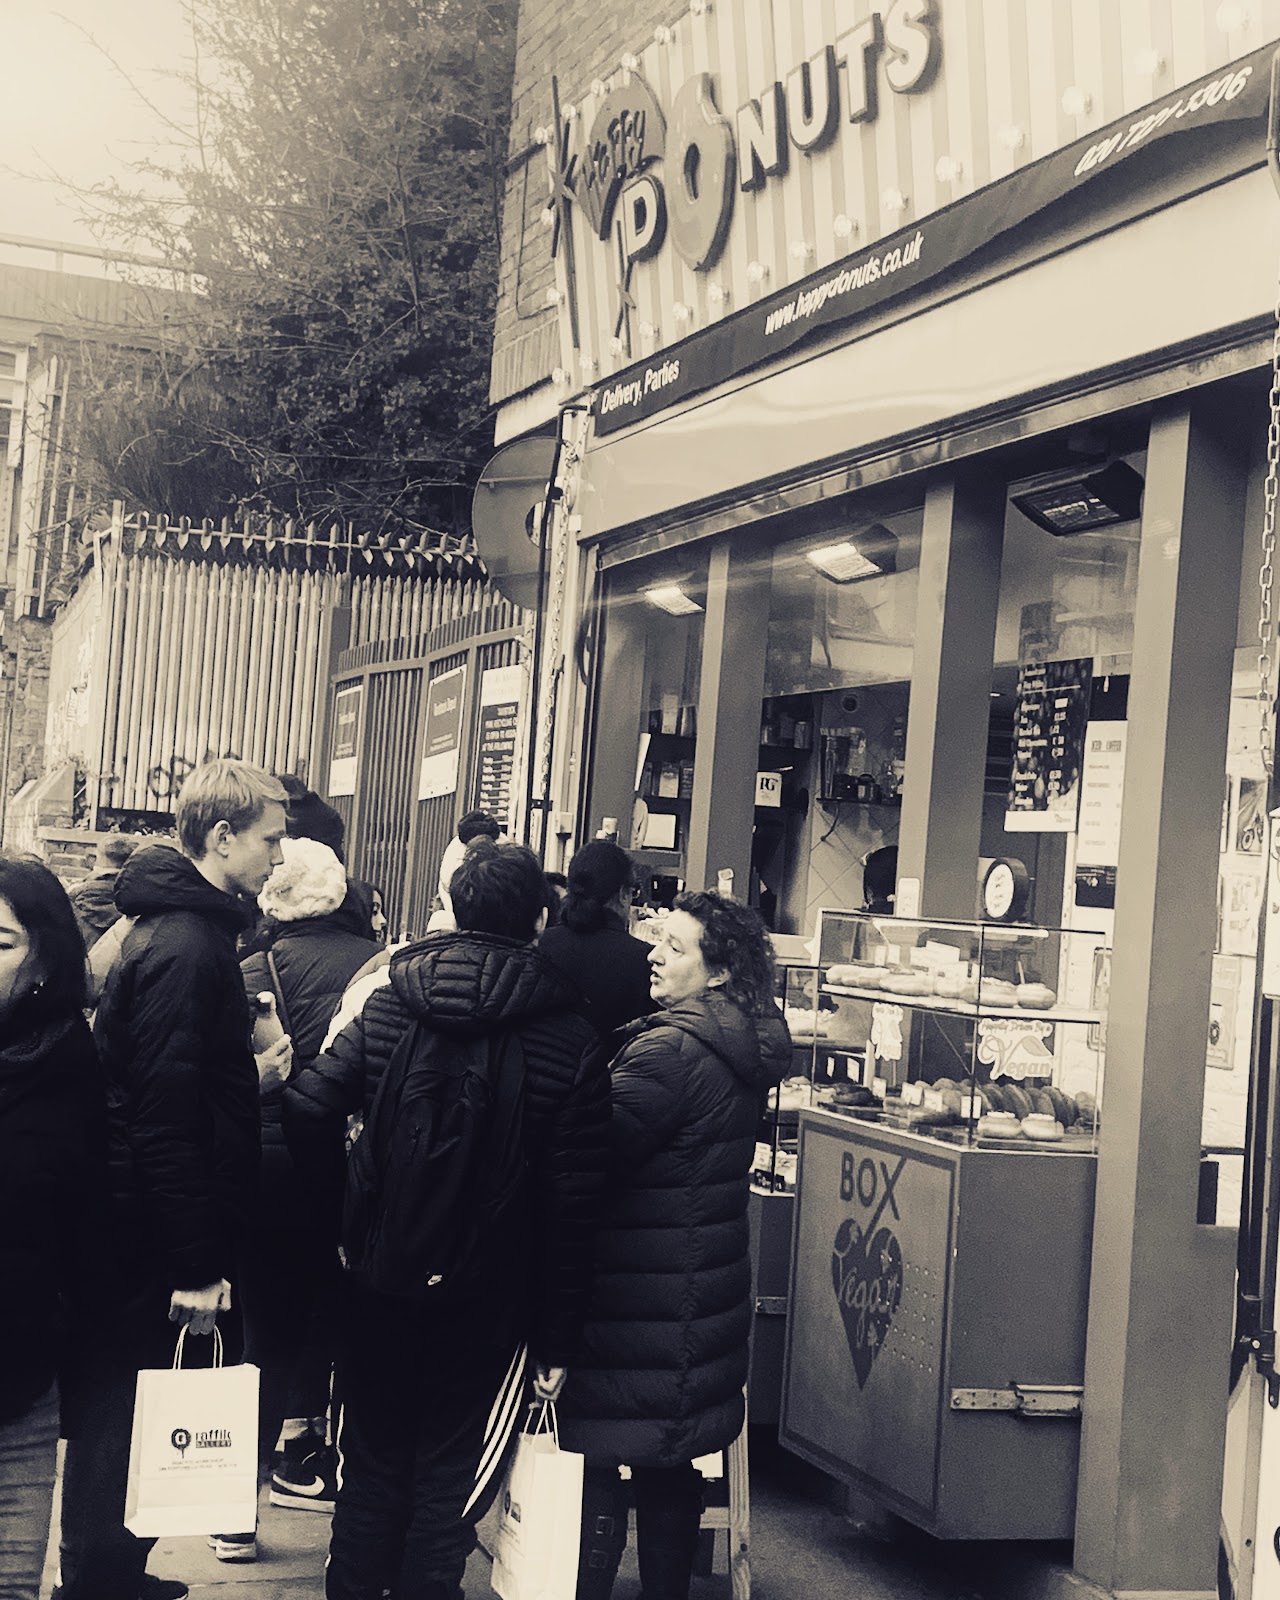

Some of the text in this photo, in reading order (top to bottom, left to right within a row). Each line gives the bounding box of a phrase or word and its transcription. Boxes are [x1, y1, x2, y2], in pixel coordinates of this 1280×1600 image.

[1074, 132, 1123, 176] 020
[764, 231, 924, 335] www.happydonuts.co.uk
[601, 360, 680, 415] Delivery, Parties
[981, 1035, 1050, 1078] Vegan
[840, 1151, 907, 1237] BOX
